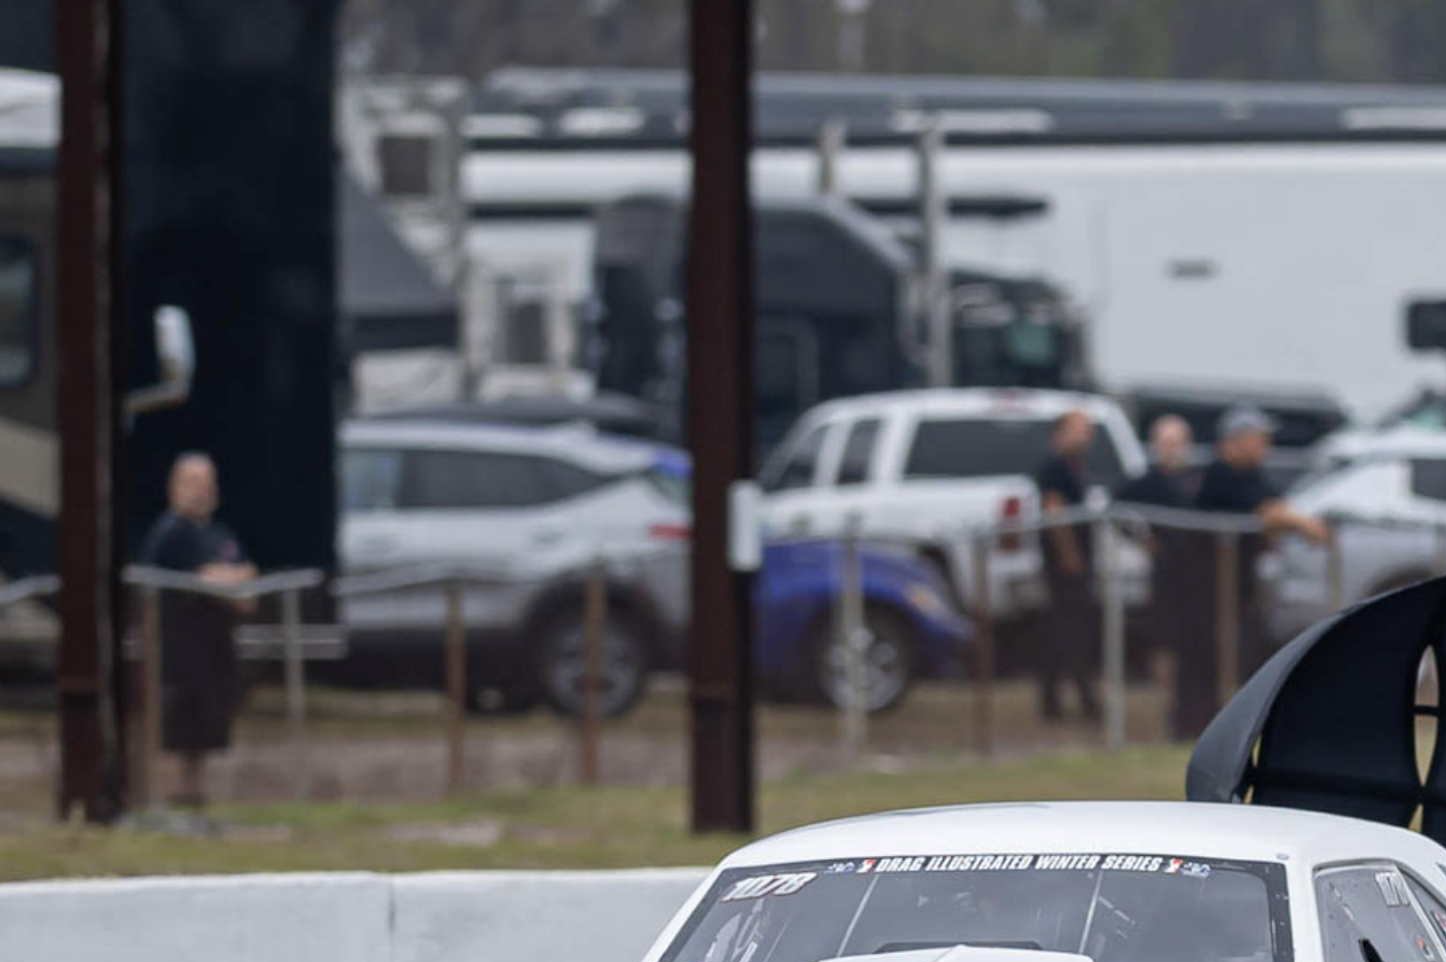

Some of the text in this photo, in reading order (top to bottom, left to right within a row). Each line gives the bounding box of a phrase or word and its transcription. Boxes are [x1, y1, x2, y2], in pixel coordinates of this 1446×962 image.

[875, 857, 926, 872] DRAG
[925, 855, 1033, 871] ILLUSTRATED
[1034, 854, 1100, 870] WINTER
[1101, 855, 1163, 872] SERIES
[720, 873, 818, 901] 1078
